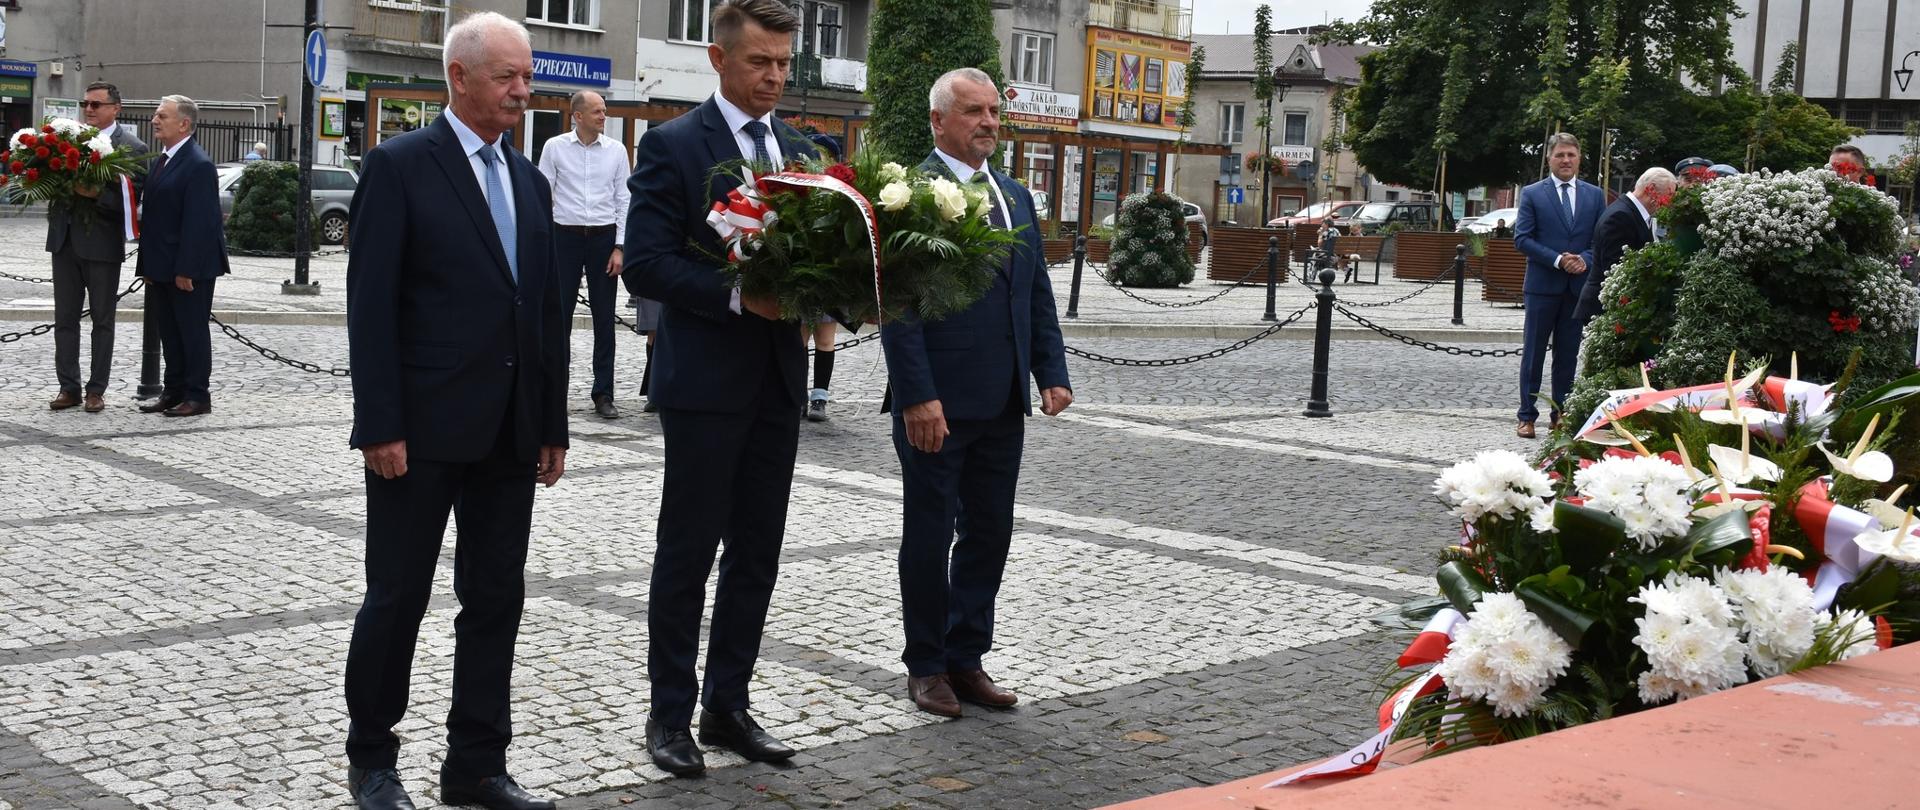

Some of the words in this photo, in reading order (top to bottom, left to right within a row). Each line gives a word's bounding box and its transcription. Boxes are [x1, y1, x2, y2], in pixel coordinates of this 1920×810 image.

[75, 61, 82, 72] 3
[533, 58, 588, 79] ZPIECZENIA
[1008, 99, 1041, 114] TWÓRSTWA
[1274, 151, 1311, 159] CARMEN
